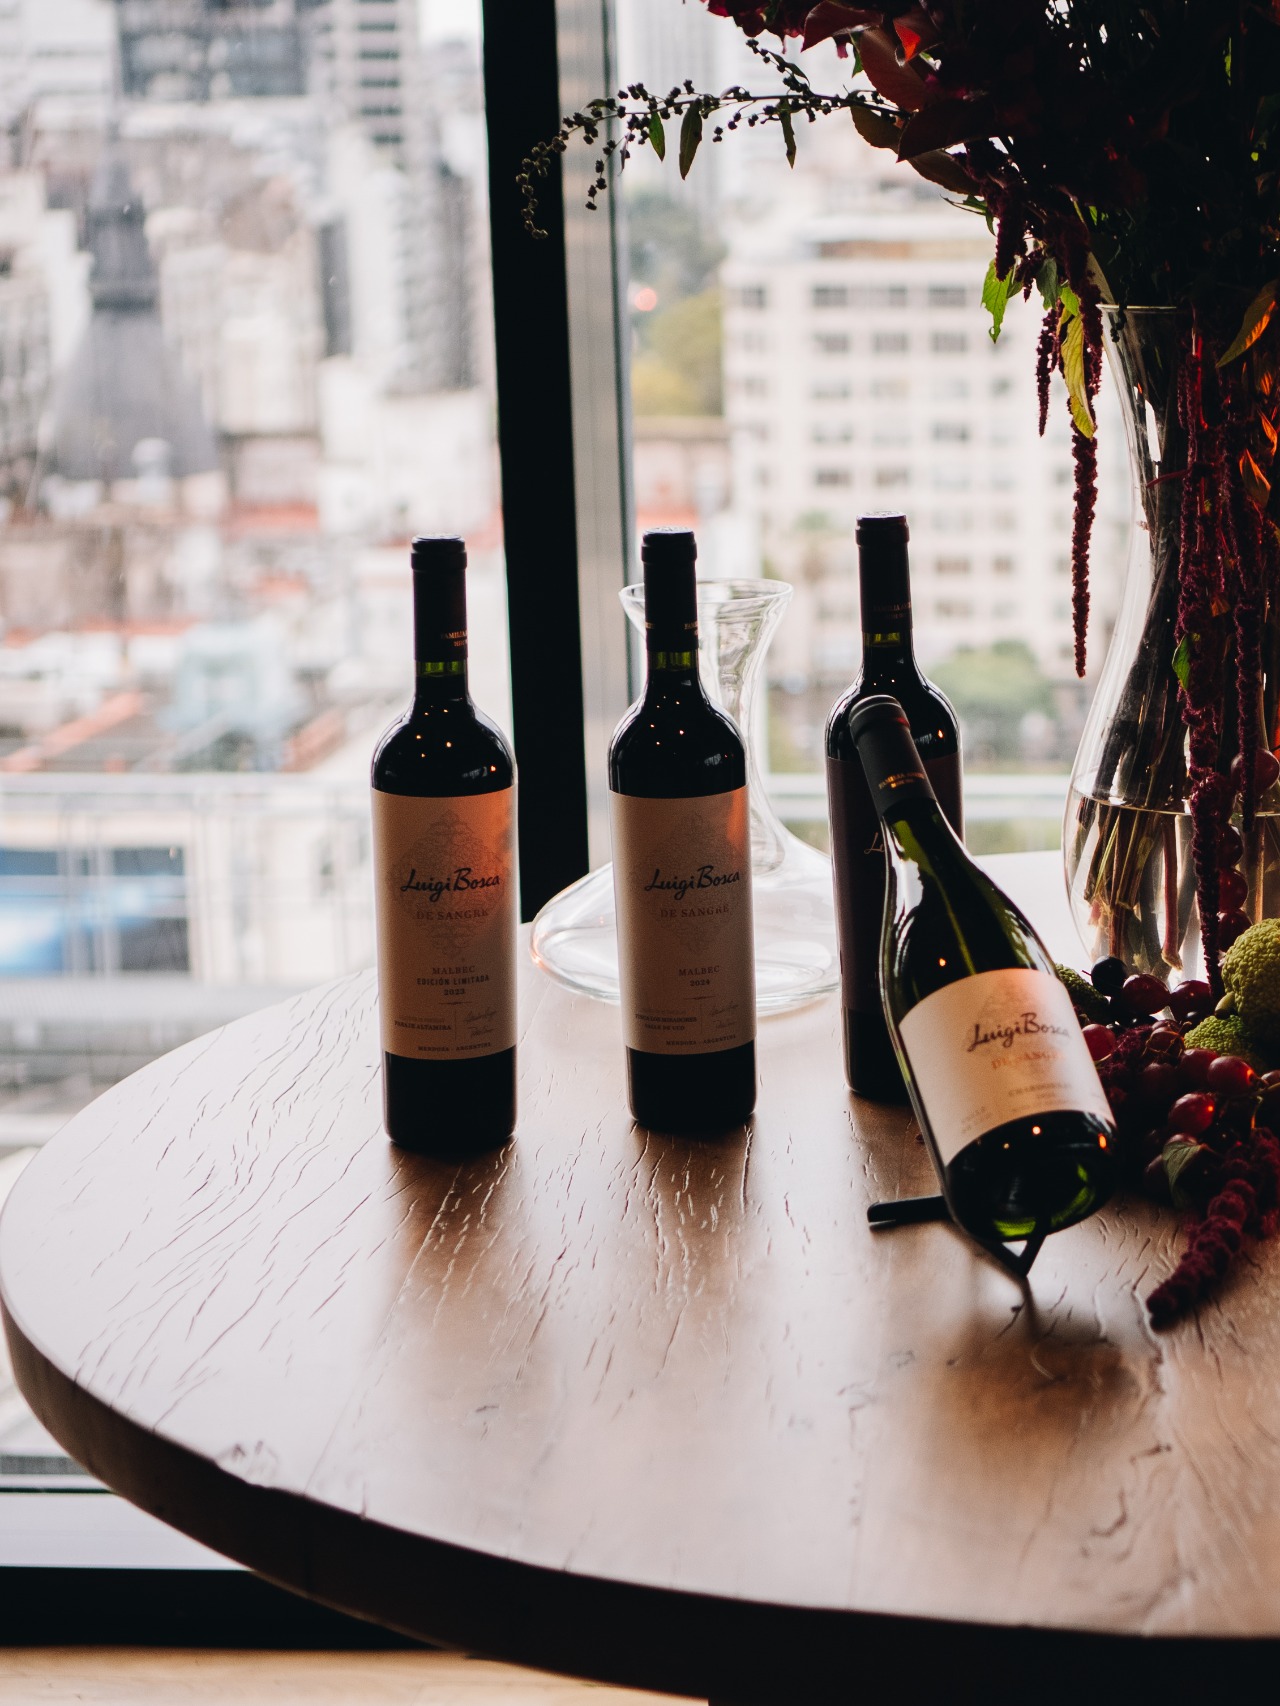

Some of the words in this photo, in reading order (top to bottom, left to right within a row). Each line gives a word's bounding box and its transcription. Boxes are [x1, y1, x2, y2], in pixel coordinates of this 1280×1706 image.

[400, 868, 450, 902] Luigi
[453, 867, 500, 891] Bosca
[645, 868, 695, 901] Luigi
[697, 865, 741, 889] Bosca
[416, 911, 434, 921] DE
[437, 909, 489, 921] SANGRE
[660, 909, 677, 918] DE
[681, 904, 730, 918] SANGRE
[432, 965, 476, 975] MALBEC
[678, 965, 720, 977] MALBEC
[416, 977, 450, 986] EDICIÓN
[453, 974, 490, 985] LIMITADA
[689, 979, 711, 987] 2024
[966, 1022, 1021, 1052] Luigi
[1020, 1012, 1070, 1036] Bosca
